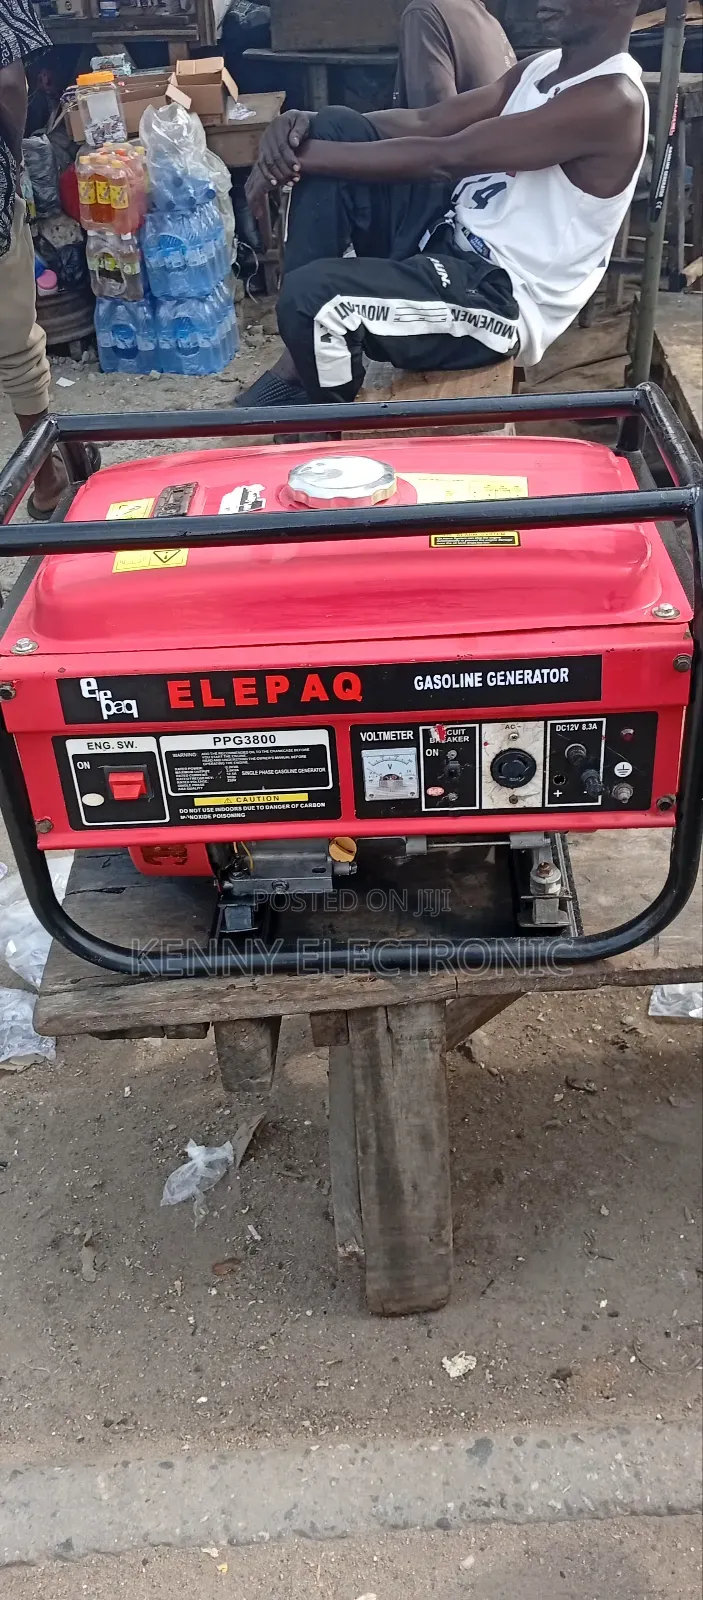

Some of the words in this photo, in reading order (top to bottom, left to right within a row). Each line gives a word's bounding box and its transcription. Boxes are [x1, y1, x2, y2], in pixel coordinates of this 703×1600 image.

[414, 672, 482, 690] GASOLINE
[487, 668, 569, 686] GENERATOR
[168, 672, 362, 708] ELEPAQ
[556, 724, 579, 732] DC12V
[213, 735, 276, 746] PPG3800
[360, 731, 414, 741] VOLTMETER
[87, 742, 114, 750] ENG.
